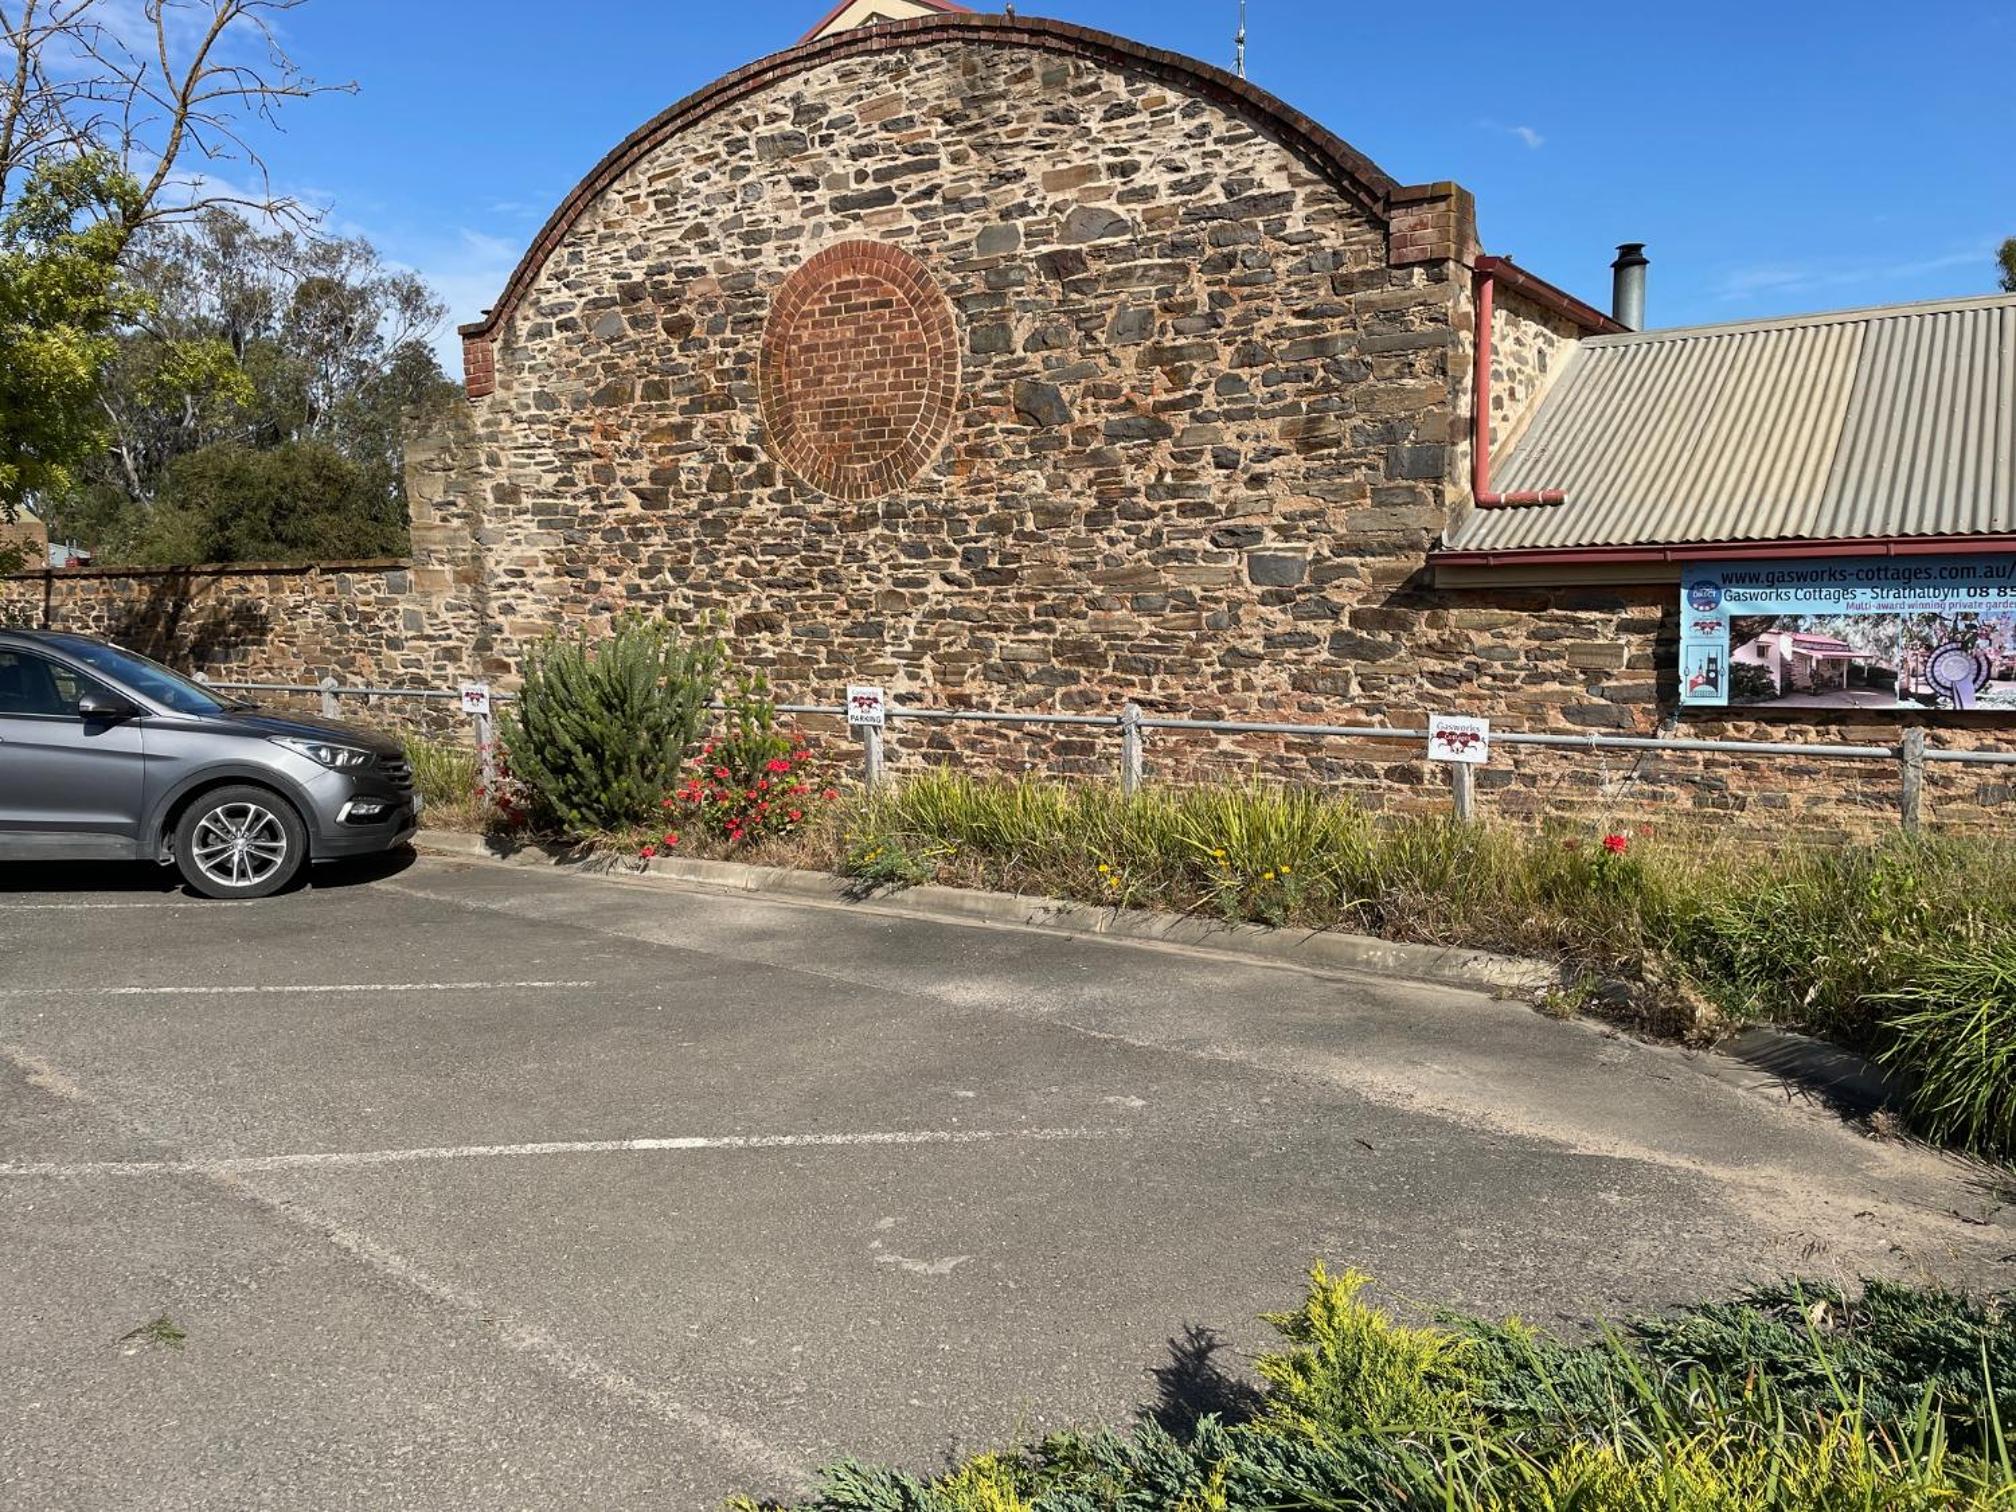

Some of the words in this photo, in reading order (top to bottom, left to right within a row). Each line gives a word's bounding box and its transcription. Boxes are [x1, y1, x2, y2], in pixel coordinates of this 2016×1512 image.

[1723, 588, 1791, 602] Gasworks
[1794, 586, 1857, 604] Cottages
[1870, 585, 1959, 601] Strathalbyn
[1967, 585, 1990, 598] 08
[1846, 601, 1906, 611] Multi-award
[1907, 601, 1946, 612] winning
[1947, 601, 1982, 612] private
[1985, 600, 2016, 611] garde
[850, 714, 881, 724] PARKING
[1436, 721, 1480, 732] Gasworks
